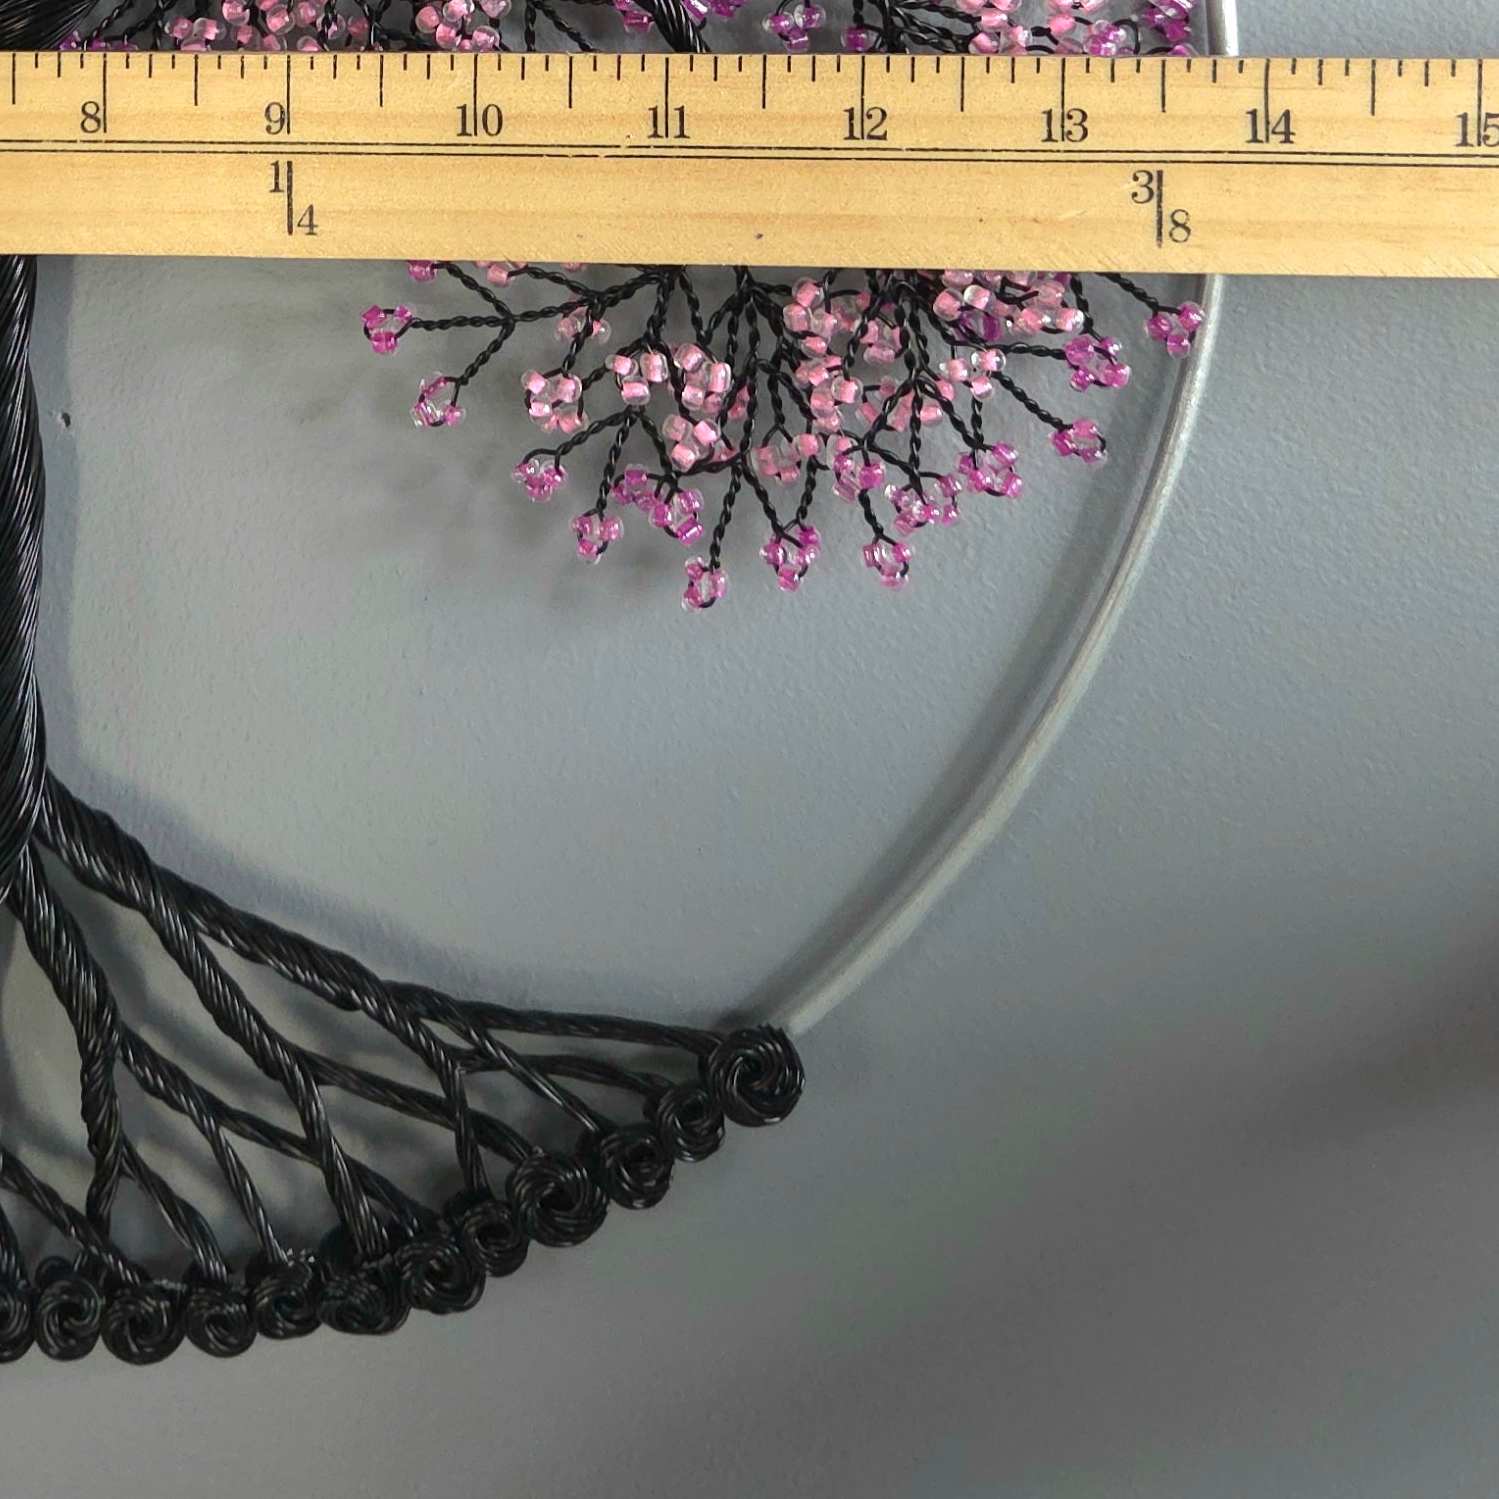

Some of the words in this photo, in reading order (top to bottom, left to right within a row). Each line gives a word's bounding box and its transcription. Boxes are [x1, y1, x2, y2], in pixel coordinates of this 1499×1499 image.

[80, 101, 102, 133] 8
[264, 102, 285, 134] 9
[456, 103, 503, 137] 10
[647, 105, 690, 139] 11
[843, 106, 888, 141] 12
[1041, 107, 1088, 143] 13
[1246, 108, 1295, 145] 14
[1454, 111, 1499, 147] 15
